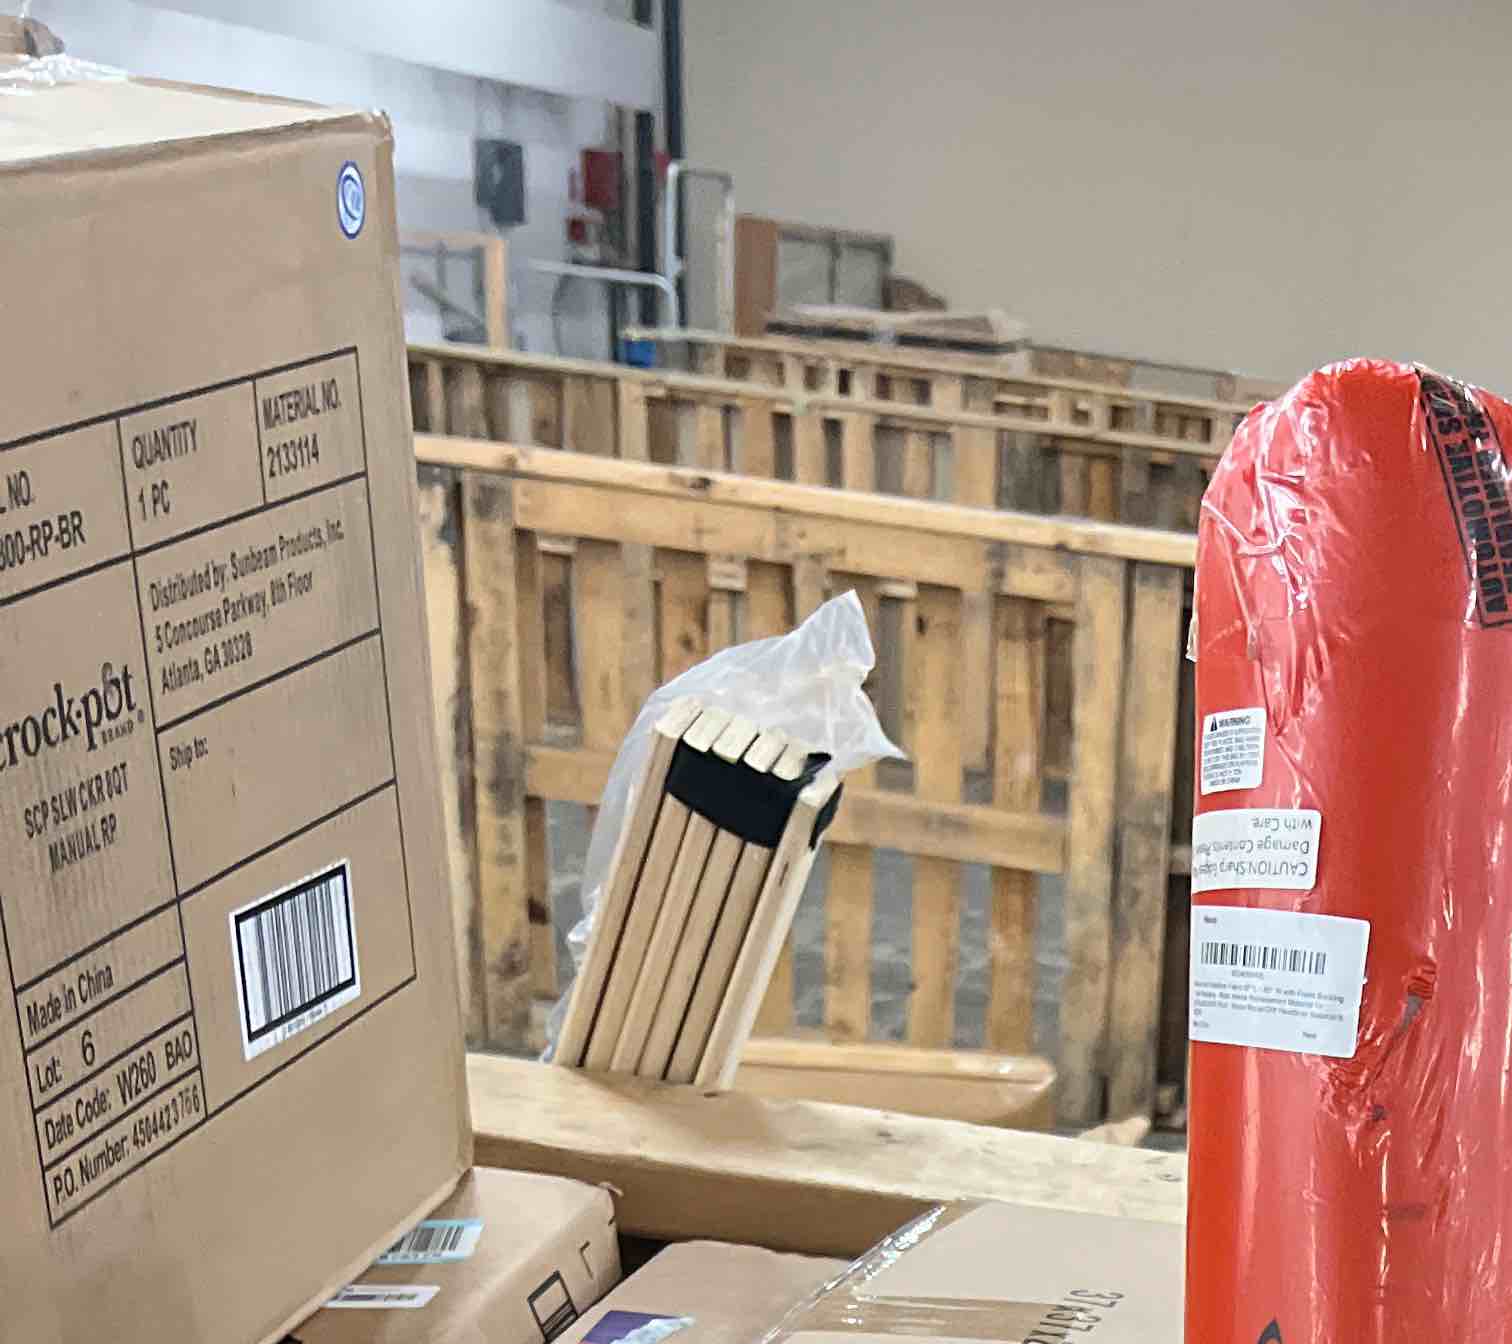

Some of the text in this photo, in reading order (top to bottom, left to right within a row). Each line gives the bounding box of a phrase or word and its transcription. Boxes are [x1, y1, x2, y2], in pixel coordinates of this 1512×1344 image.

[262, 378, 342, 430] MATERIAL NO.
[132, 418, 198, 470] QUANTITY
[138, 479, 171, 521] 1 PC
[150, 562, 212, 612] Distributed
[230, 541, 277, 582] Sunbeam
[164, 605, 222, 648] Concourse
[161, 655, 205, 694] Atlanta,
[204, 643, 222, 675] GA
[169, 744, 193, 771] Ship
[24, 800, 50, 839] SCP
[50, 784, 79, 826] SLW
[78, 771, 106, 812] CKR
[48, 813, 118, 873] MANUAL RP
[27, 964, 114, 1036] Made in China
[36, 1029, 96, 1094] Lot: 6
[44, 1109, 74, 1151] Date
[75, 1087, 112, 1130] Code:
[116, 1051, 156, 1107] W260
[79, 1135, 131, 1187] Number:
